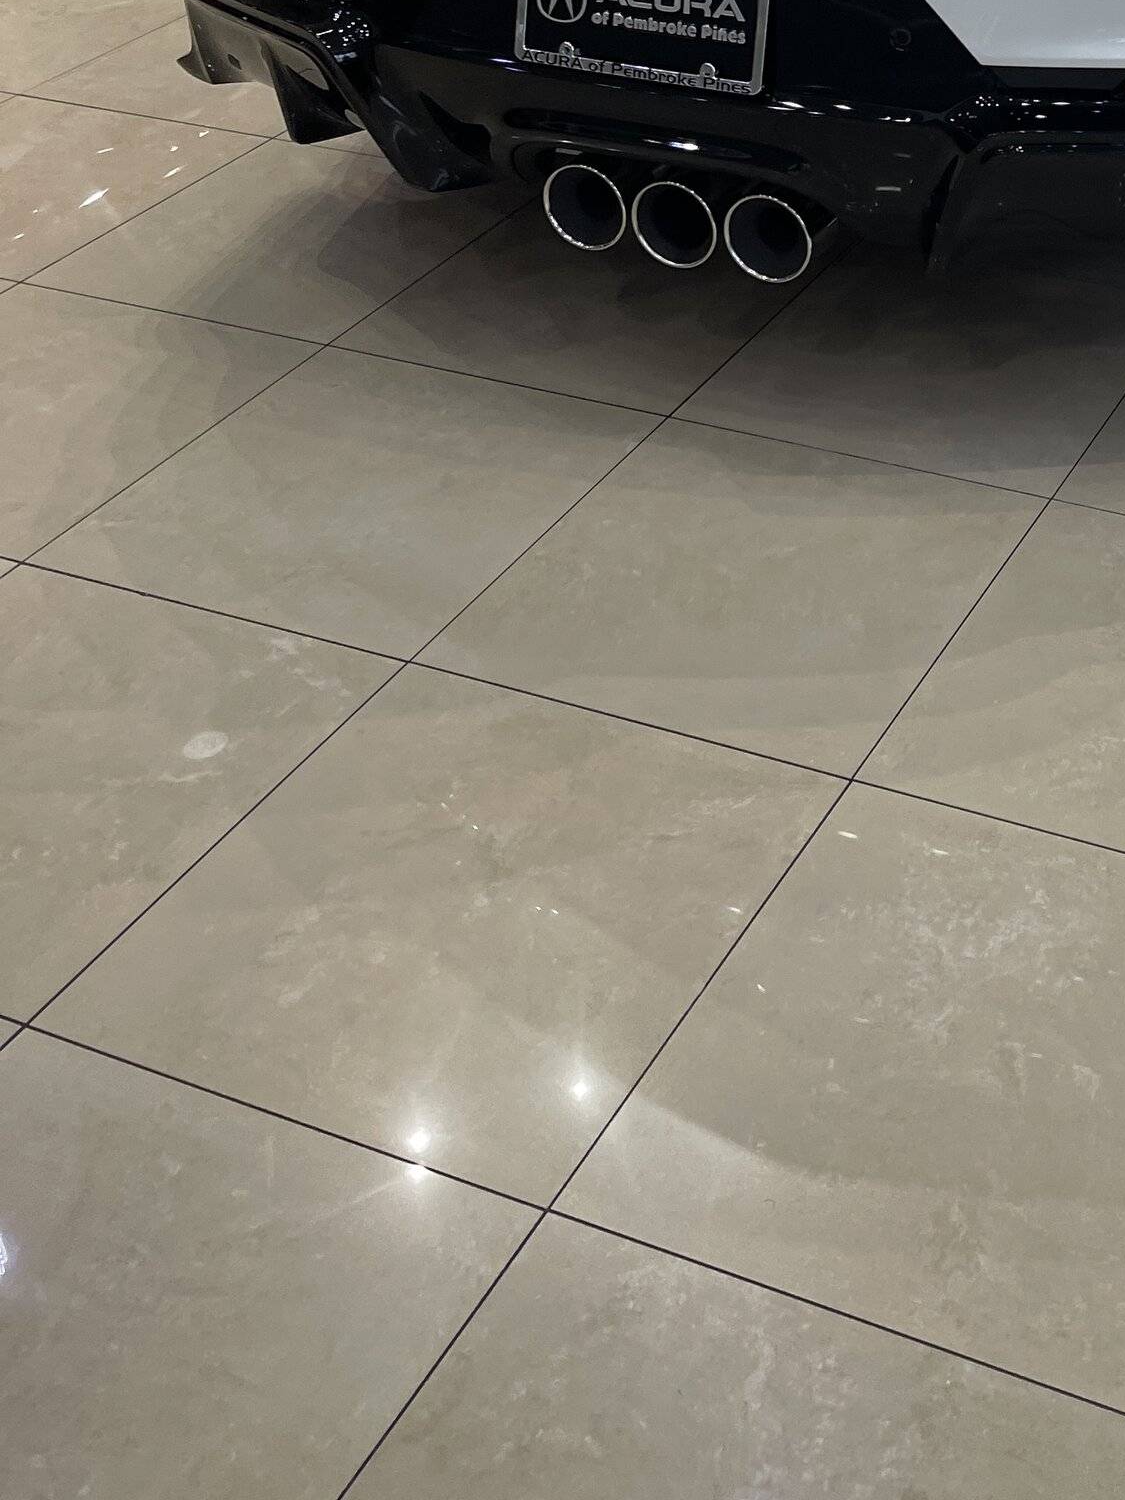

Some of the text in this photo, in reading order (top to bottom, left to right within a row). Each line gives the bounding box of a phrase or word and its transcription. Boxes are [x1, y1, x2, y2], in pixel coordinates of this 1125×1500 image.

[591, 9, 746, 45] of Pembroke Pines
[522, 50, 751, 95] ACURA of Pembroke Pines
